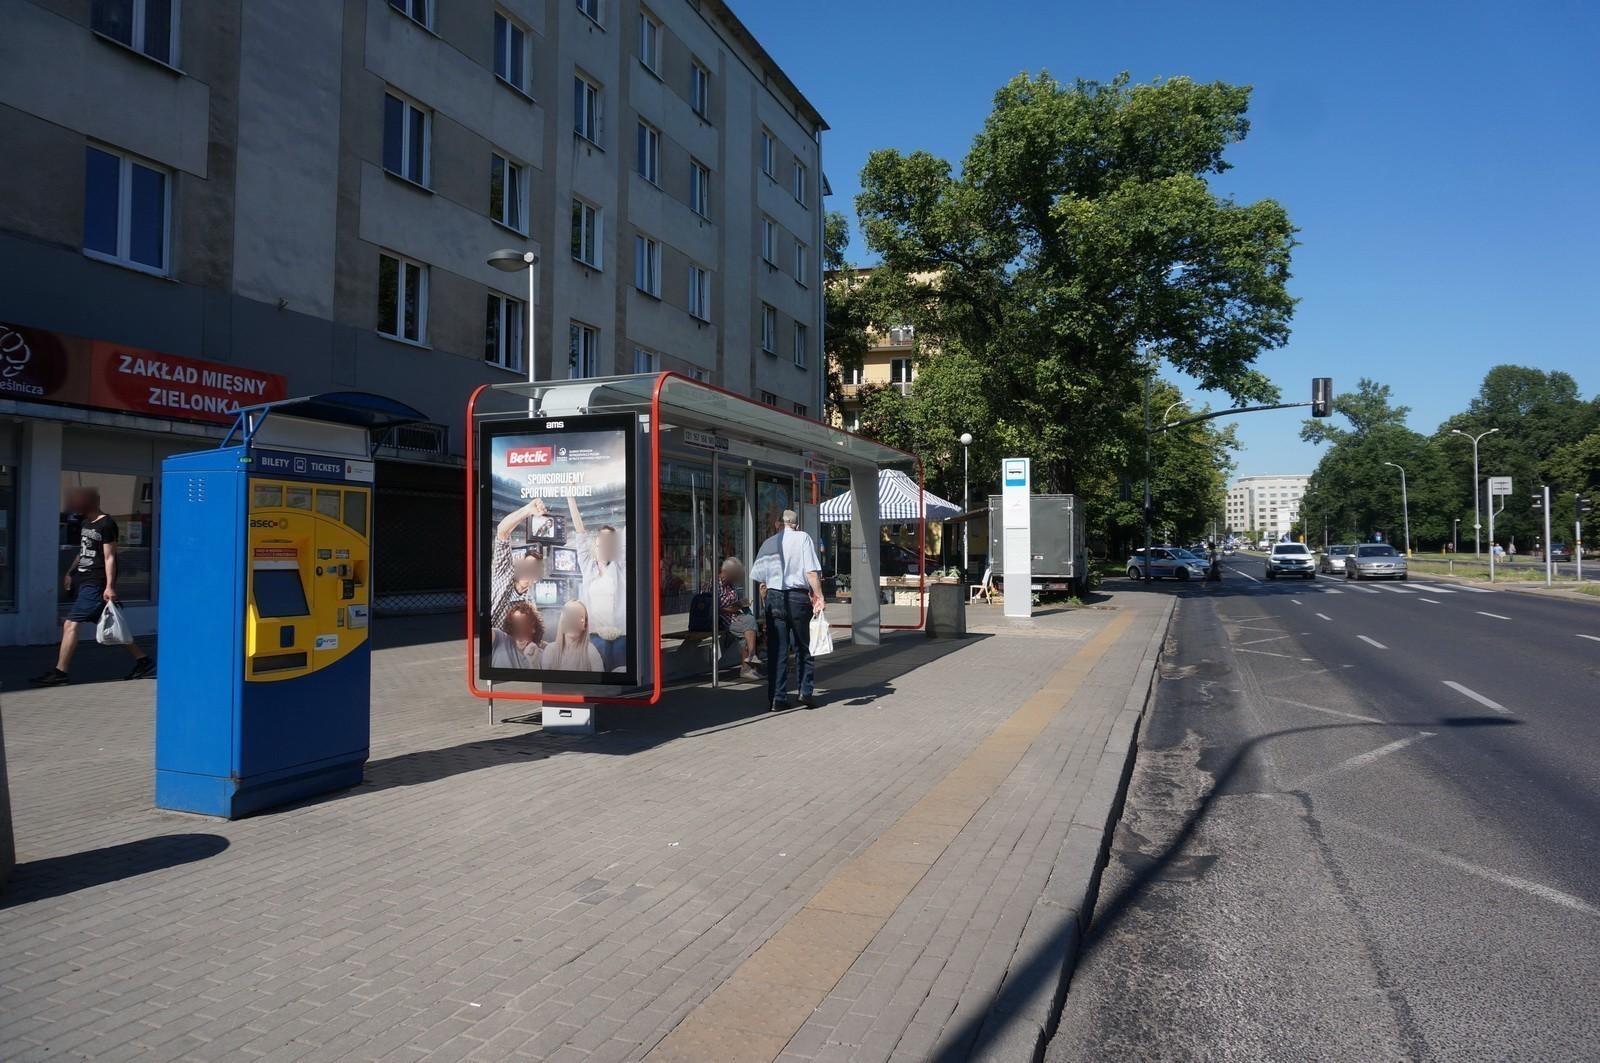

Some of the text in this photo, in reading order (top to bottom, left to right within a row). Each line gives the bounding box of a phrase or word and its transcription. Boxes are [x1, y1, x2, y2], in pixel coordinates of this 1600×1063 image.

[118, 355, 268, 396] ZAKŁAD MIĘSNY
[545, 420, 565, 429] ams
[509, 450, 548, 464] Betclic
[261, 456, 290, 468] BILETY
[311, 462, 341, 473] TICKETS
[527, 471, 585, 485] SPONSORUJEMY
[520, 485, 592, 499] SPORTOWE EMOCJE!
